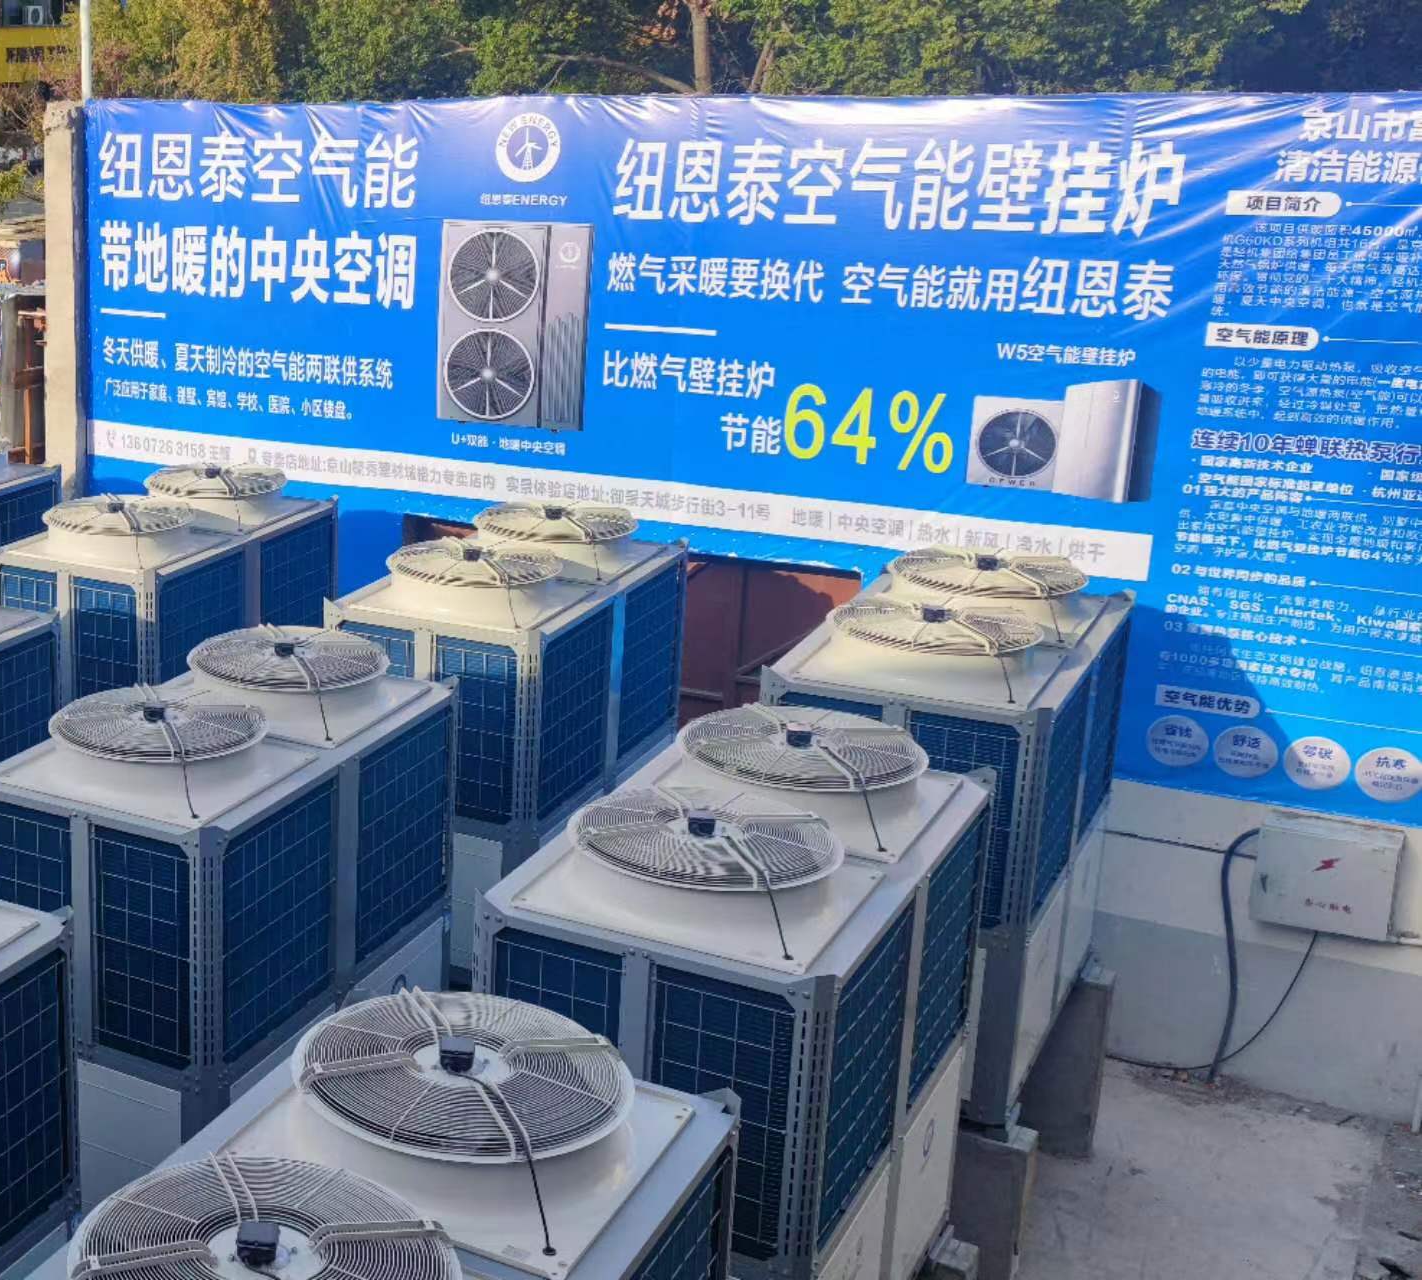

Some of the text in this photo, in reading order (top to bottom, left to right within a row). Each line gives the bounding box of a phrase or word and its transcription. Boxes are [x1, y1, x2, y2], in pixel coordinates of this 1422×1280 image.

[98, 131, 419, 209] 纽恩泰空气能
[1273, 150, 1422, 184] 清洁能源
[612, 137, 1187, 238] 纽恩泰空气能壁挂炉
[1245, 195, 1321, 213] 项目简介
[99, 220, 418, 309] 带地暖的中央空调
[606, 252, 1175, 321] 燃气采暖要换代 空气能就用纽恩泰
[1215, 327, 1309, 346] 空气能原理
[103, 335, 394, 390] 冬天供暖、夏天制冷的空气能两联供系统
[996, 342, 1136, 368] W5空气能壁挂炉
[601, 349, 776, 400] 比燃气壁挂炉
[720, 383, 954, 475] 节能 64%
[1190, 428, 1422, 465] 连续10年蝉联热泵行
[1182, 484, 1201, 496] 01
[1371, 485, 1422, 502] 杭州亚
[792, 507, 824, 530] 地暖
[837, 513, 905, 538] 中央空调
[917, 523, 951, 544] 热水
[1068, 540, 1107, 564] 烘干
[1171, 563, 1191, 576] 02
[1163, 690, 1251, 715] 空气能优势
[1232, 734, 1261, 749] 舒适
